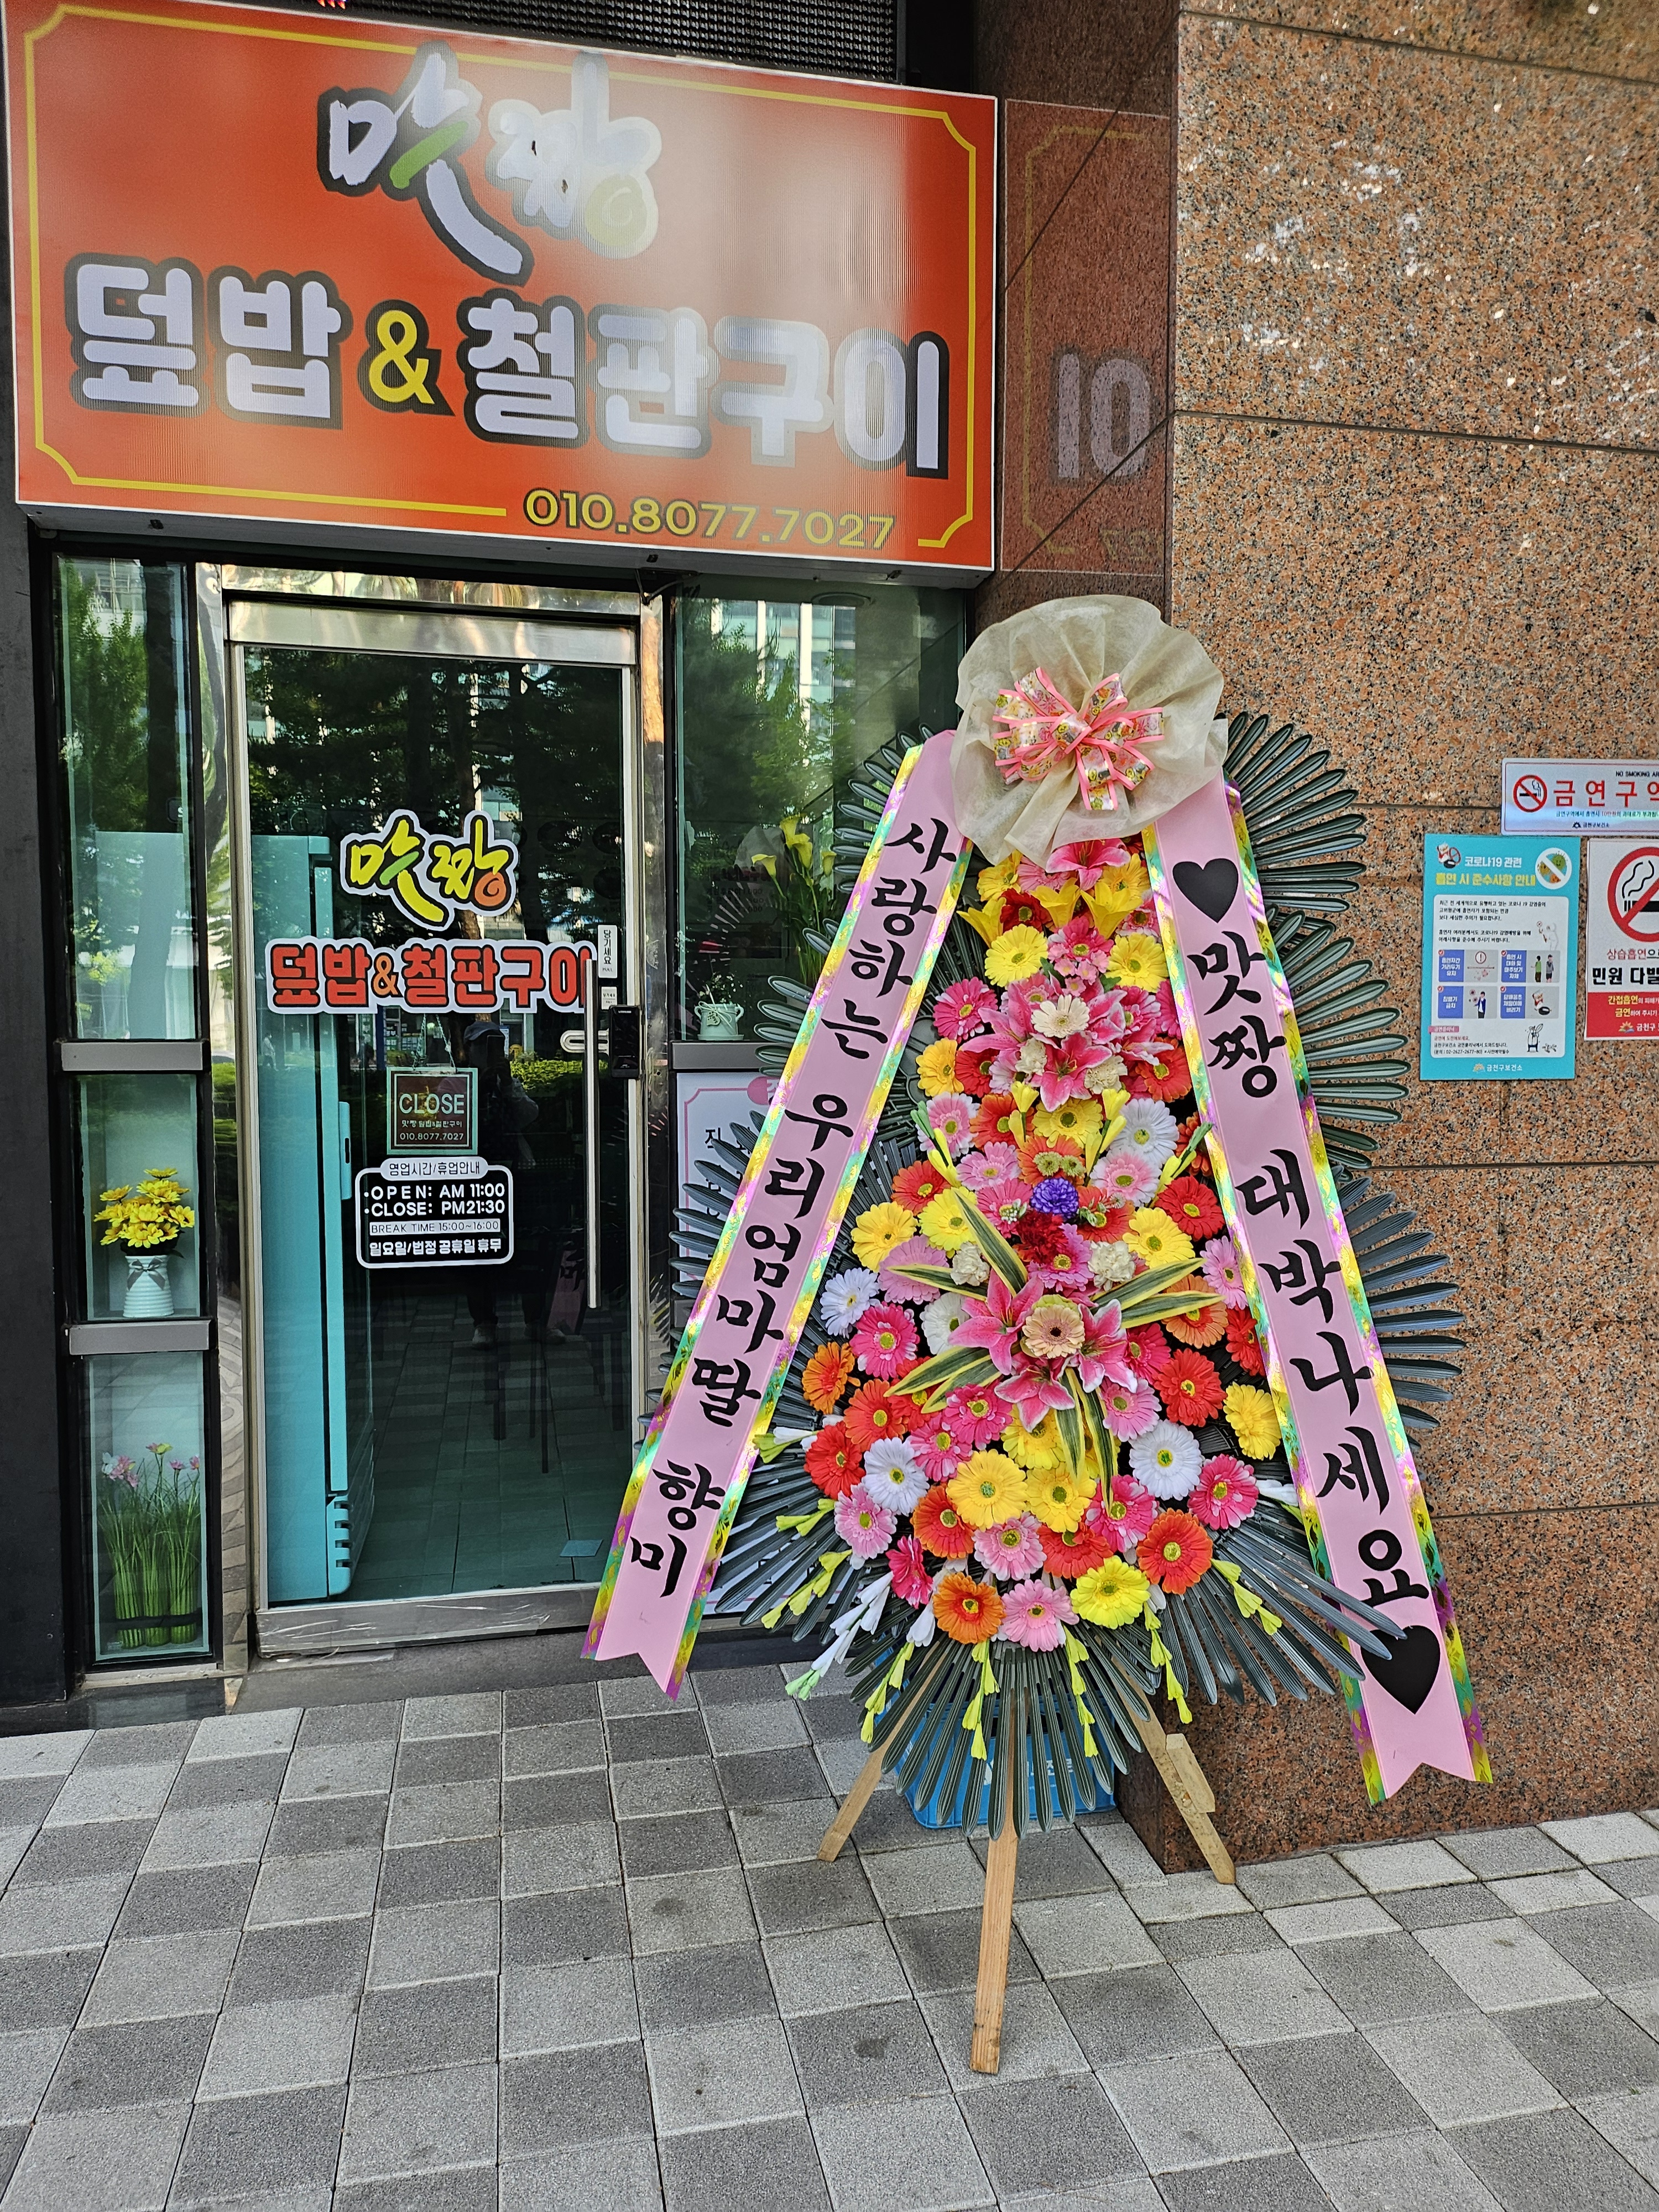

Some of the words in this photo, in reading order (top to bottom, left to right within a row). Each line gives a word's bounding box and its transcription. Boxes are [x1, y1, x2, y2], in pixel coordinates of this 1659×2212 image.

[324, 47, 655, 279] 맛짱
[523, 487, 897, 551] 010.8077.7027
[348, 813, 514, 925] 맛짱
[1464, 856, 1502, 868] 코로나19
[1504, 857, 1522, 868] 관련
[1435, 873, 1457, 885] 흡연
[1459, 873, 1470, 885] 시
[1472, 873, 1512, 886] 준수사항
[1515, 874, 1536, 886] 안내
[821, 817, 958, 1060] 사랑하는
[603, 929, 612, 964] 당기세요
[1607, 948, 1659, 960] 상습흡연으
[1592, 967, 1623, 985] 민원
[1608, 995, 1644, 1005] 간접흡연의
[1187, 930, 1287, 1099] 맛짱
[1615, 1008, 1641, 1018] 금연하여
[1636, 1023, 1655, 1032] 금천구
[1486, 1063, 1523, 1072] 금천구보건소
[399, 1093, 465, 1114] CLOSE
[401, 1119, 417, 1128] 맛짱
[399, 1133, 464, 1141] 010.8077.7027
[439, 1184, 465, 1198] AM
[470, 1183, 505, 1197] 11:00
[371, 1224, 407, 1234] BREAK
[411, 1223, 435, 1232] TIME
[439, 1239, 476, 1254] 공휴일
[478, 1238, 502, 1253] 휴무
[629, 1458, 726, 1599] 향미
